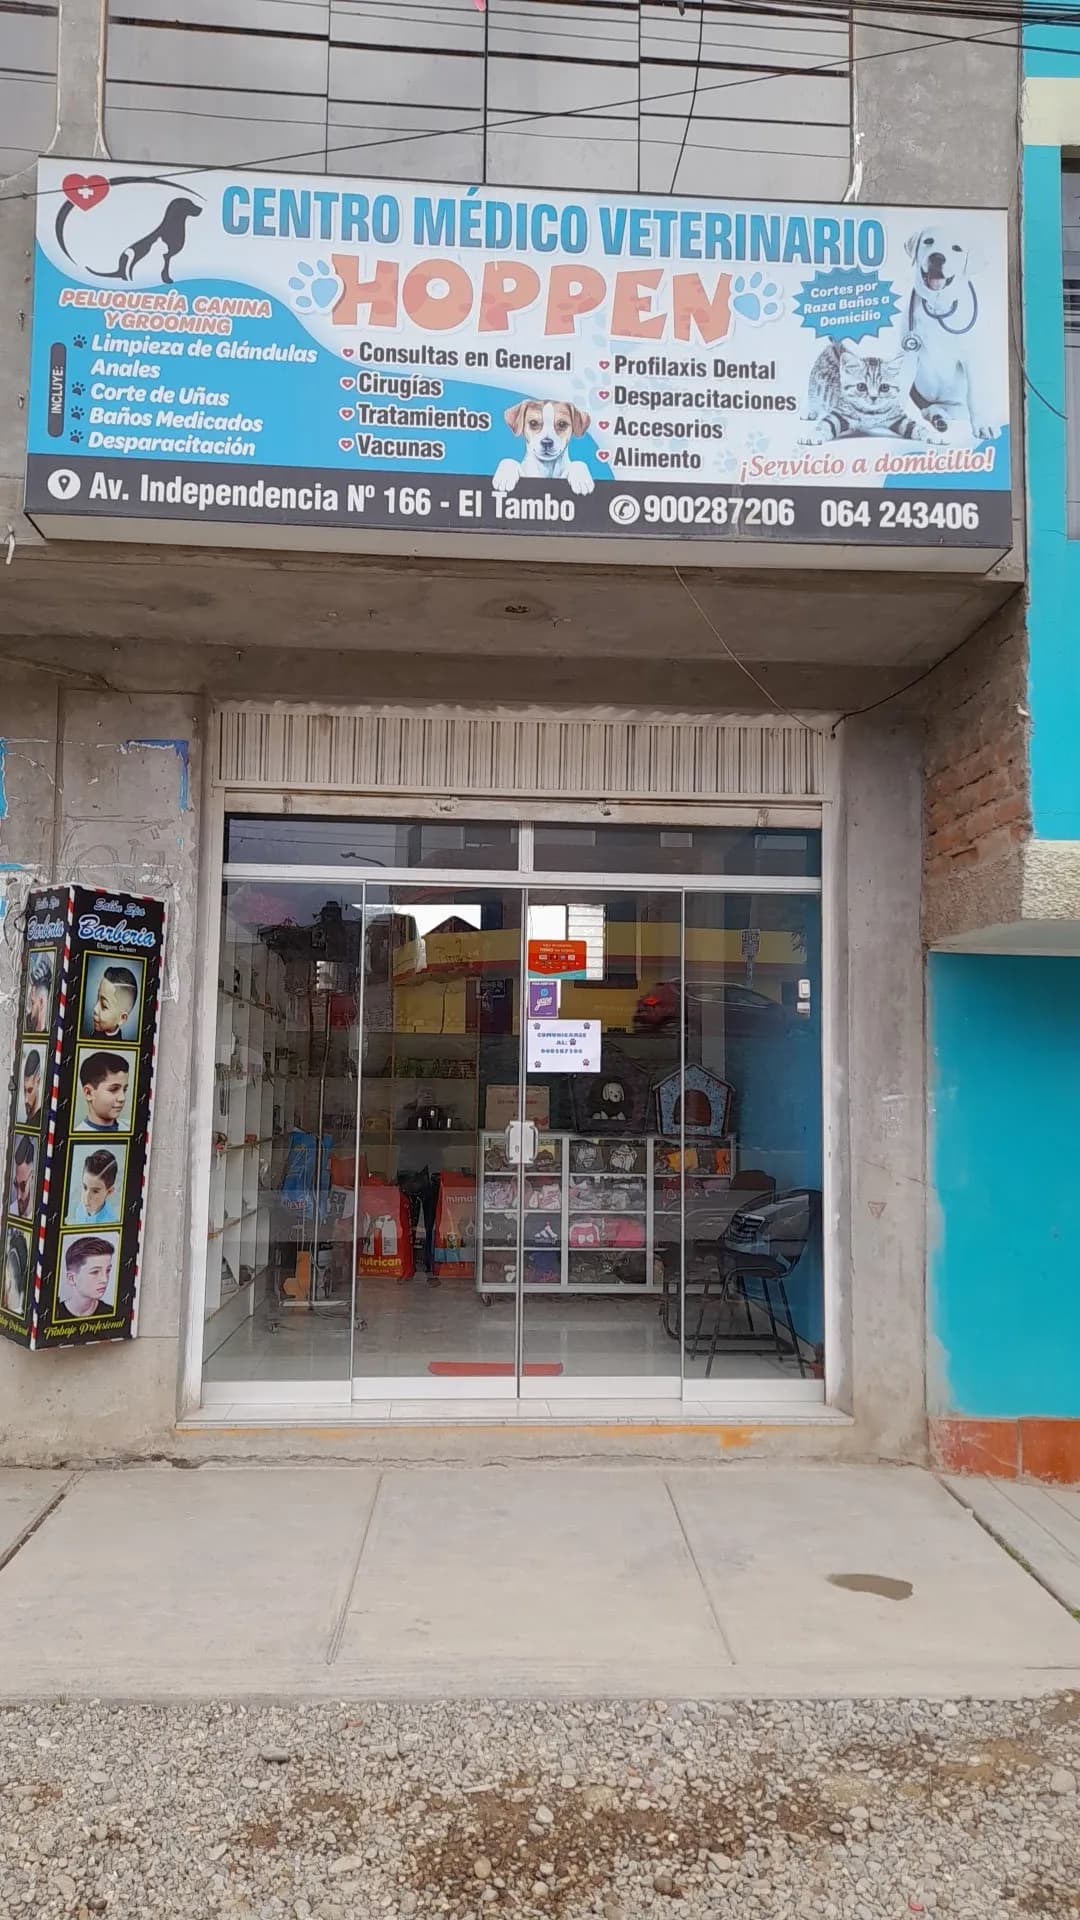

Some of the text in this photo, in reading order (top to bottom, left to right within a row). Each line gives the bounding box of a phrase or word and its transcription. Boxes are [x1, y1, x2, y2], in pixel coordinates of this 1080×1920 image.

[221, 185, 885, 268] CENTRO MÉDICO VETERINARIO
[331, 253, 733, 344] HOPPEN
[811, 281, 878, 298] Cortes por
[60, 288, 271, 317] PELUQUERÍA CANINA
[804, 294, 890, 316] Raza Baños a
[820, 312, 881, 327] Domicilio
[91, 335, 317, 363] Limpieza de Glándulas
[359, 342, 571, 370] Consultas en General
[90, 359, 161, 378] Anales
[614, 355, 776, 380] Profilaxis Dental
[51, 365, 64, 415] INCLUYE:
[90, 383, 229, 407] Corte de Uñas
[358, 372, 442, 398] Cirugías
[614, 385, 797, 411] Desparacitaciones
[89, 408, 264, 432] Baños Medicados
[358, 404, 490, 429] Tratamientos
[613, 416, 723, 439] Accesorios
[88, 431, 255, 456] Desparacitación
[357, 435, 444, 458] Vacunas
[613, 447, 701, 469] Alimento
[740, 448, 994, 482] ¡Servicio a domicilio!
[89, 472, 129, 500] Av.
[140, 474, 339, 511] Independencia
[383, 487, 431, 515] 166
[458, 489, 482, 518] El
[492, 490, 575, 521] Tambo
[643, 495, 796, 526] 900287206
[820, 500, 871, 528] 064
[879, 501, 979, 529] 243406
